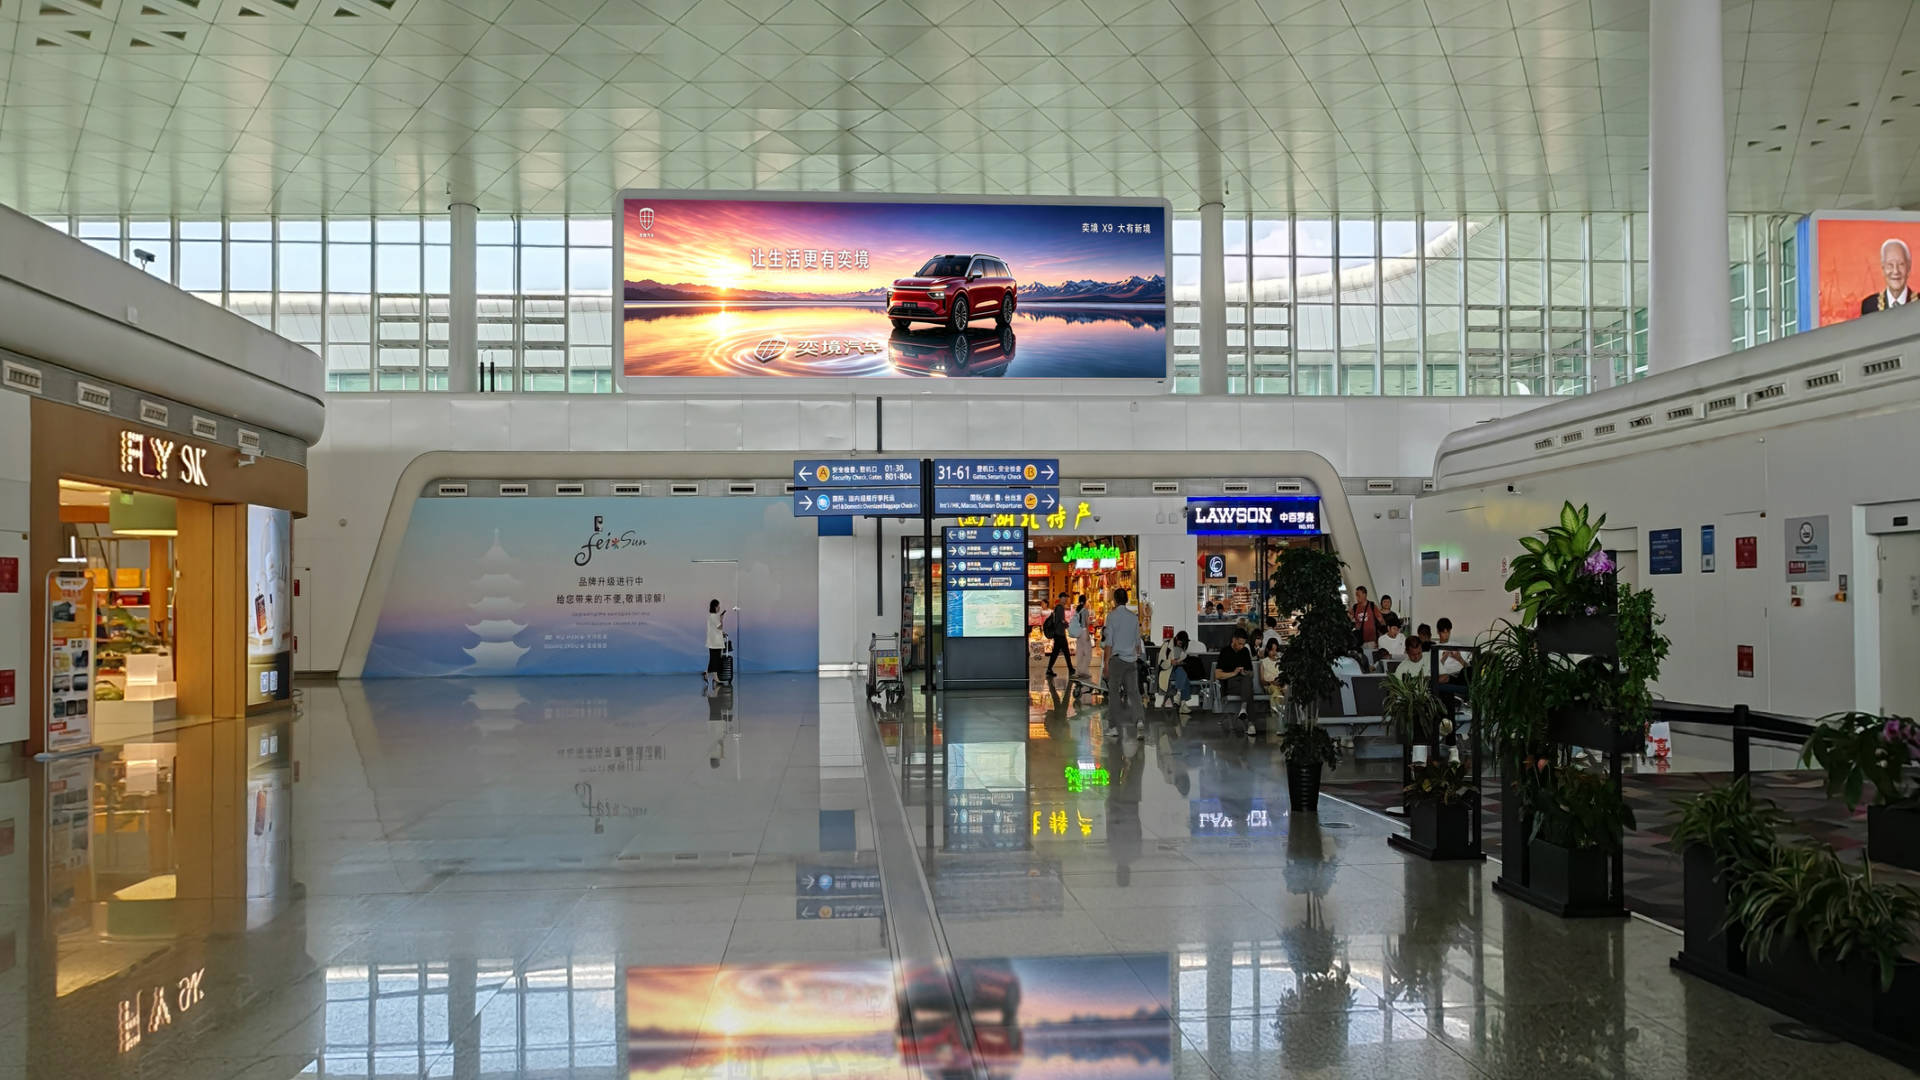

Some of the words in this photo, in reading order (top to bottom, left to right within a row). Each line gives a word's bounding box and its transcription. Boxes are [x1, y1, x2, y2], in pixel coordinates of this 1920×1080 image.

[1101, 223, 1113, 233] X9
[1117, 223, 1151, 234] 大有新境
[750, 248, 870, 269] 让生活更有奕境
[794, 340, 883, 357] 奕境汽车
[938, 465, 970, 480] 31-61
[1195, 507, 1272, 524] LAWSON
[1279, 512, 1315, 523] 中百罗森
[578, 576, 643, 587] 品牌升级进行中
